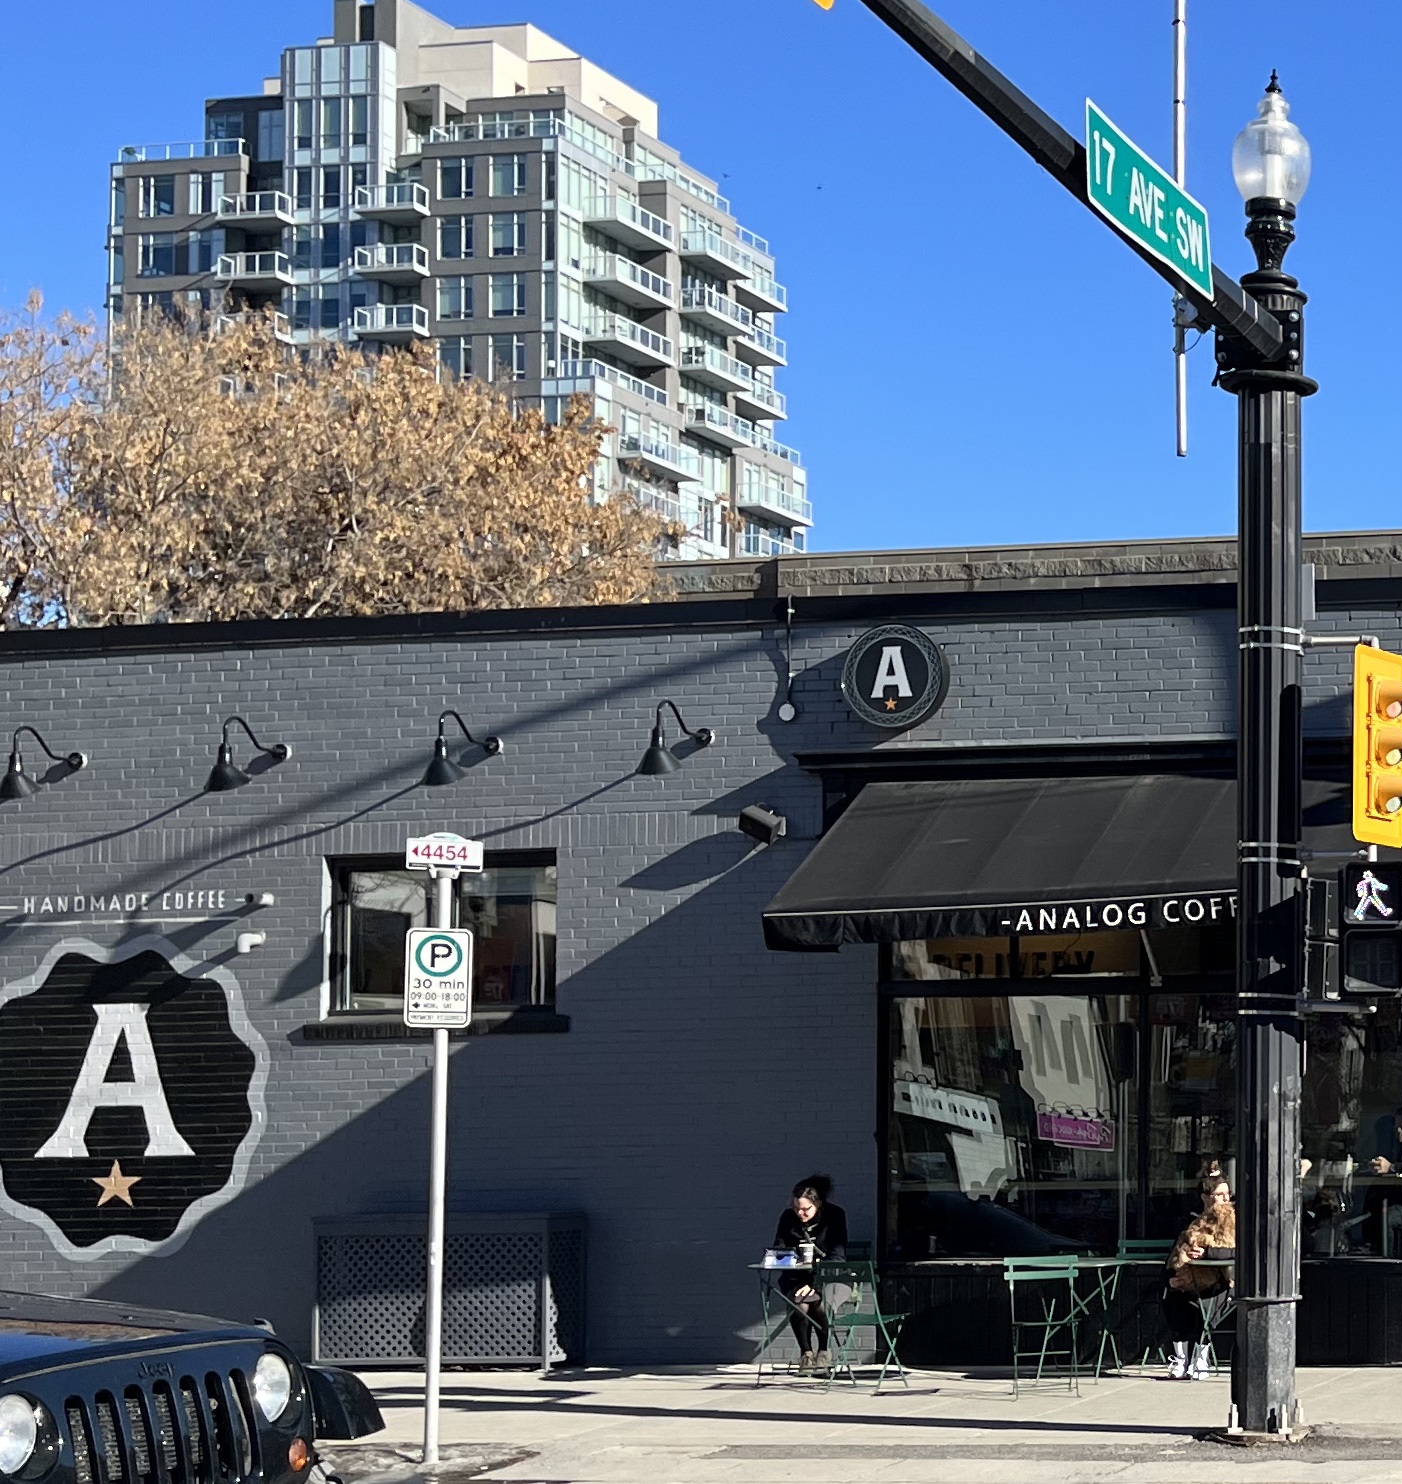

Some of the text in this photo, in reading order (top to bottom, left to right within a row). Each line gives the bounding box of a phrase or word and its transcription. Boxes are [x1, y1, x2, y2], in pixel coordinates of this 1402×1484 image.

[1093, 130, 1204, 272] 17 AVE SW
[871, 645, 913, 698] A
[421, 844, 468, 861] 4454
[23, 890, 226, 915] HANDMADE COFFEE
[1163, 896, 1238, 922] COFF
[413, 978, 465, 990] 30 min
[34, 1003, 196, 1157] A
[137, 1361, 176, 1379] Jeep
